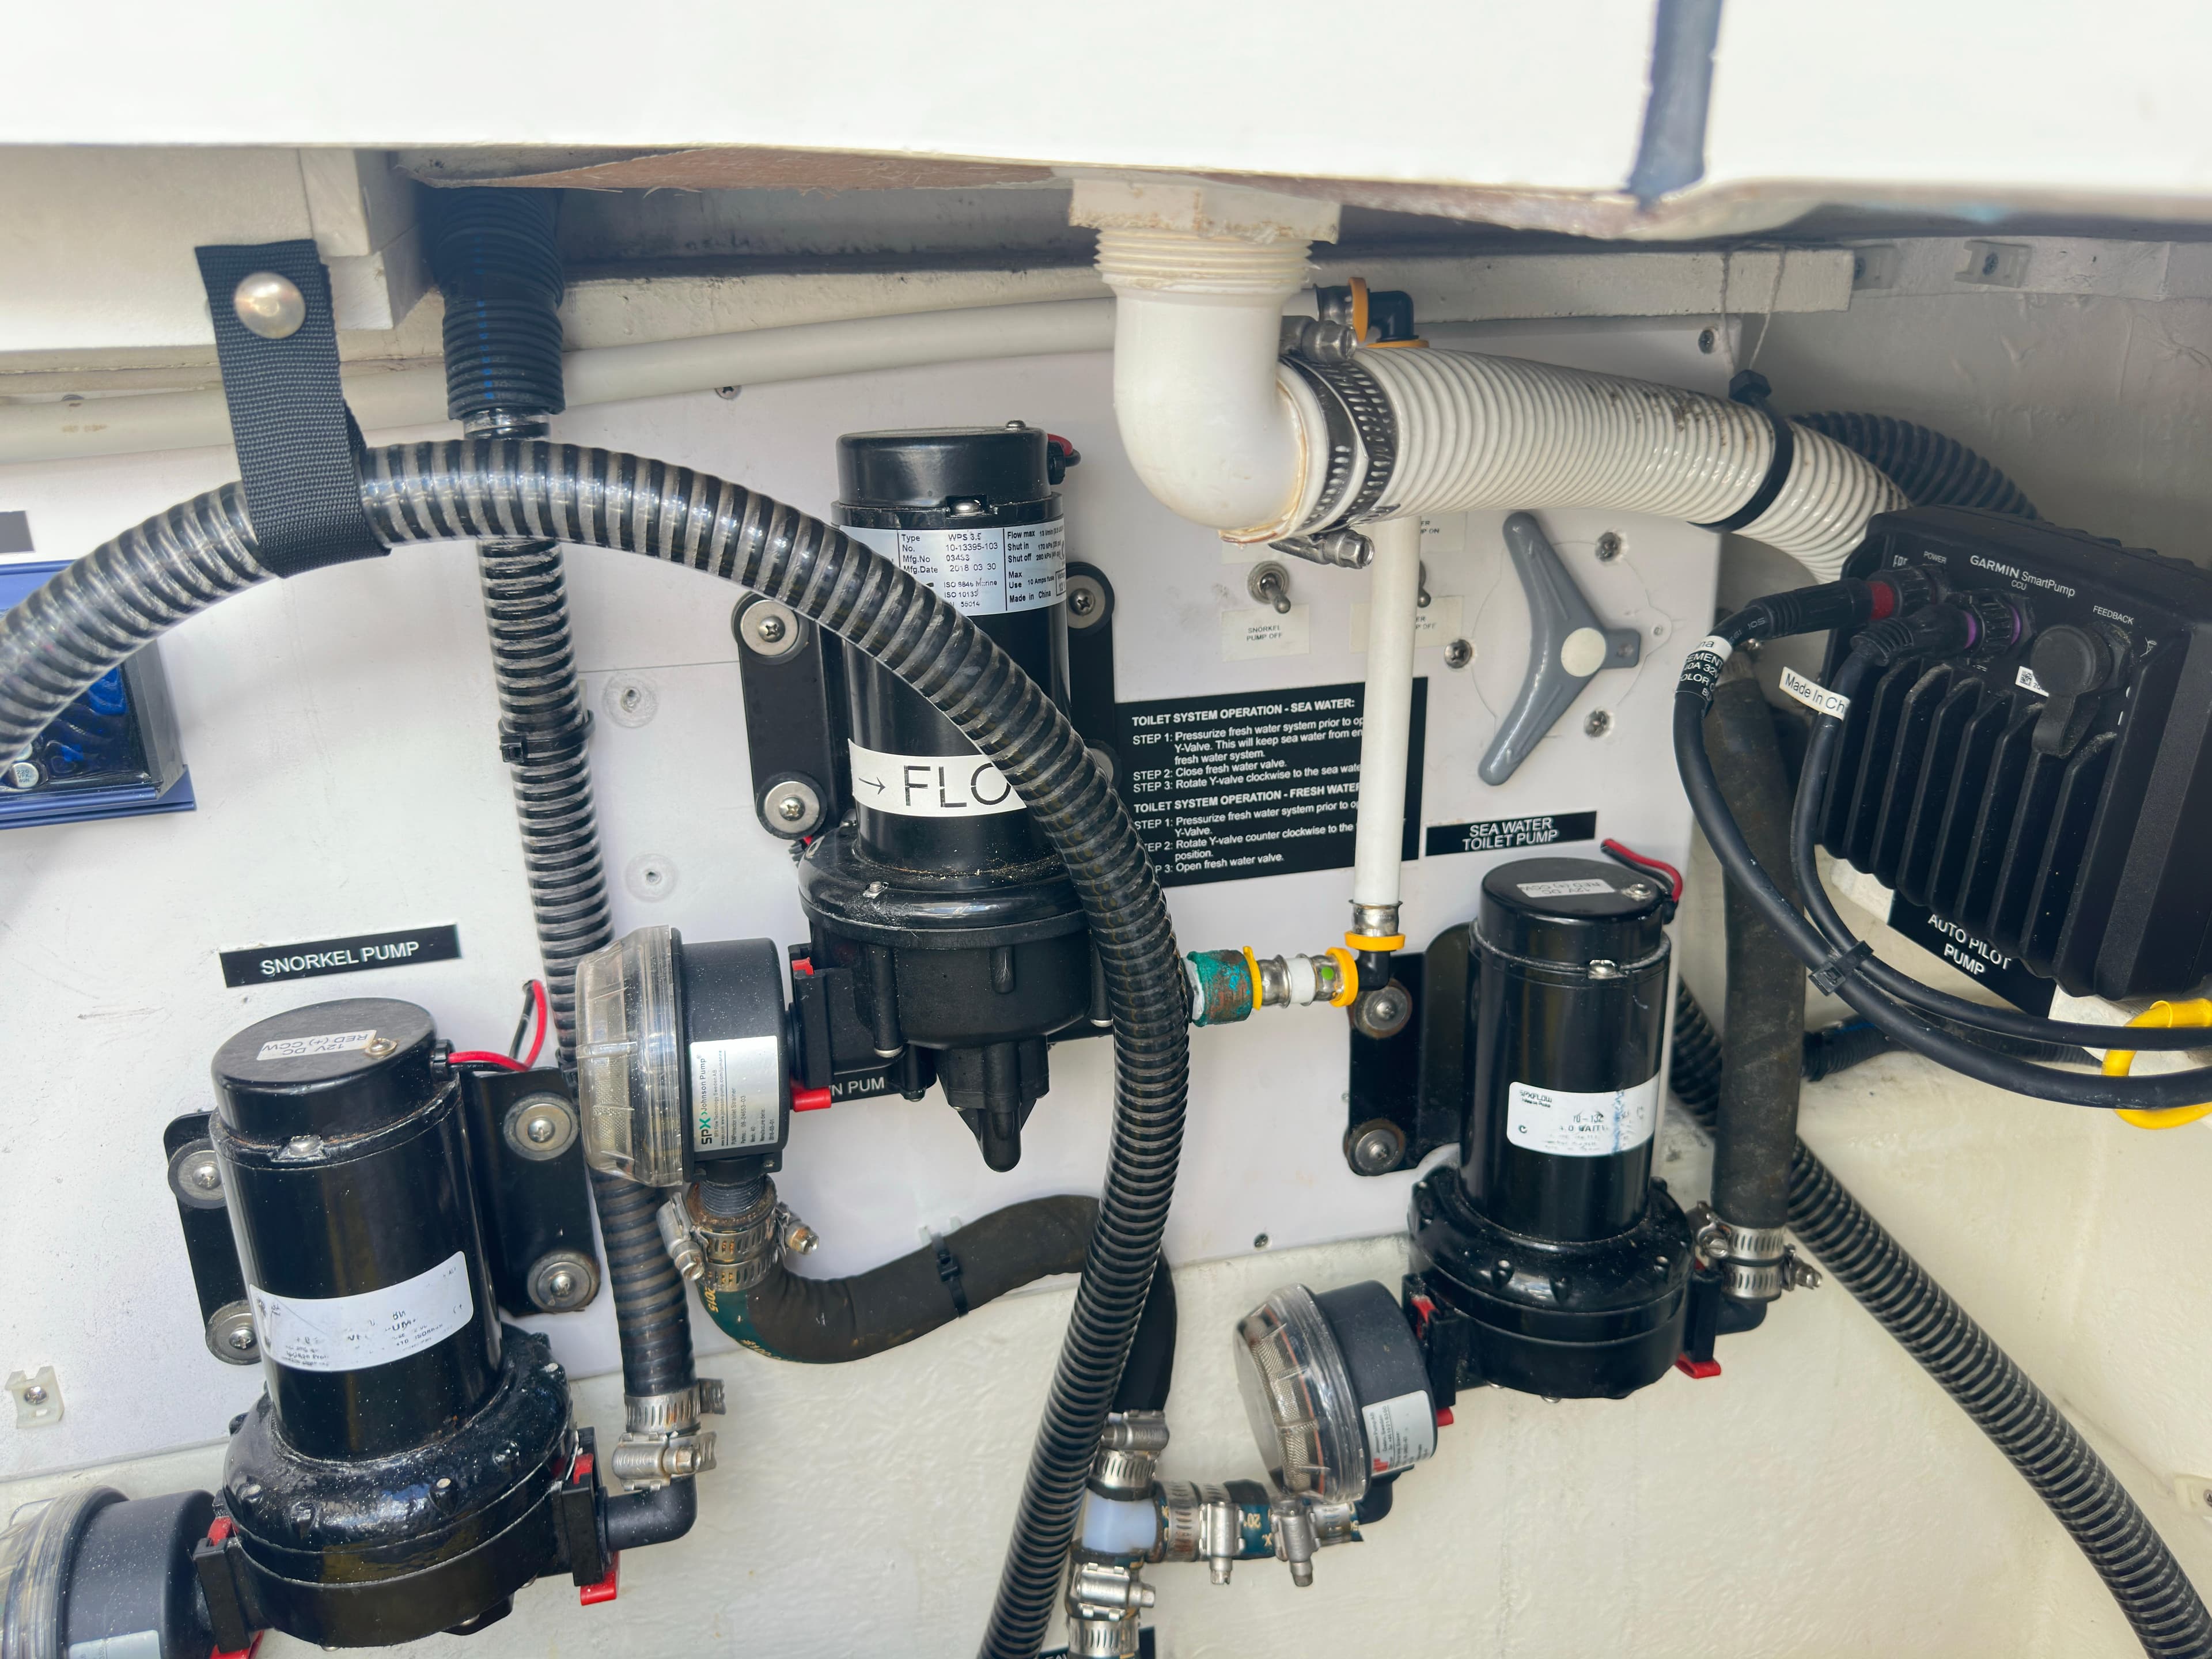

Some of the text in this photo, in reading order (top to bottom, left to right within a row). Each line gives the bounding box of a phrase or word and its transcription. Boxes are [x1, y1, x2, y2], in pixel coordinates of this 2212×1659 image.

[902, 534, 920, 542] Type
[1007, 531, 1022, 539] Flow
[946, 542, 998, 551] 10-13395-103
[1008, 543, 1022, 551] Shut
[903, 556, 930, 564] Mfg.No
[1008, 555, 1022, 563] Shut
[1923, 551, 1946, 564] POWER
[904, 566, 938, 574] Mfg.Date
[1009, 571, 1022, 579] Max
[1969, 555, 2075, 598] GARMIN SmartPump
[1035, 577, 1047, 585] Amps
[2011, 579, 2027, 590] CCU
[1009, 594, 1026, 603] Made
[1038, 590, 1051, 599] China
[2093, 605, 2134, 624] FEEDBACK
[1785, 673, 1845, 713] Made In Ch
[1132, 714, 1171, 726] TOILET
[1173, 710, 1218, 723] SYSTEM
[1219, 704, 1282, 719] OPERATION
[1290, 702, 1312, 713] SEA
[1314, 698, 1355, 710] WATER:
[1132, 733, 1161, 745] STEP
[1164, 733, 1173, 742] 1:
[1175, 729, 1226, 741] Pressurize
[1229, 725, 1252, 736] fresh
[1255, 724, 1281, 734] water
[1283, 721, 1316, 733] system
[1319, 718, 1340, 730] prior
[1342, 717, 1351, 726] to
[1175, 742, 1213, 753] Y-Valve.
[1215, 740, 1236, 749] This
[1238, 737, 1253, 748] will
[1256, 736, 1279, 746] keep
[1281, 735, 1298, 744] sea
[1300, 732, 1326, 742] water
[1328, 729, 1349, 739] from
[1175, 749, 1266, 765] fresh water system.
[1133, 759, 1287, 781] STEP 2: Close fresh water valve.
[903, 762, 1012, 808] FLO
[1133, 782, 1161, 793] STEP
[1164, 781, 1173, 790] 3:
[1176, 779, 1207, 789] Rotate
[1209, 775, 1244, 785] Y-valve
[1246, 770, 1291, 782] clockwise
[1293, 769, 1302, 777] to
[1304, 767, 1319, 777] the
[1321, 766, 1338, 775] sea
[1134, 801, 1172, 813] TOILET
[1175, 796, 1218, 809] SYSTEM
[1220, 790, 1281, 805] OPERATION
[1290, 786, 1324, 798] FRESH
[1134, 819, 1161, 830] STEP
[1165, 818, 1173, 827] 1:
[1176, 813, 1225, 825] Pressurize
[1228, 810, 1251, 820] fresh
[1253, 808, 1279, 818] water
[1282, 805, 1314, 817] system
[1316, 802, 1337, 813] prior
[1164, 841, 1173, 850] 2:
[1176, 839, 1207, 849] Rotate
[1209, 835, 1243, 846] Y-valve
[1245, 831, 1279, 842] counter
[1282, 826, 1325, 838] clockwise
[1328, 825, 1337, 833] to
[1339, 823, 1354, 832] the
[1175, 827, 1213, 837] Y-Valve.
[1469, 817, 1552, 838] SEA WATER
[1463, 830, 1559, 851] TOILET PUMP
[1164, 865, 1173, 873] 3:
[1176, 862, 1202, 873] Open
[1204, 859, 1228, 869] fresh
[1229, 856, 1255, 866] water
[1257, 853, 1284, 863] valve.
[1175, 850, 1214, 862] position.
[1927, 914, 2012, 970] AUTO PILOT
[260, 941, 419, 975] SNORKEL PUMP
[1944, 943, 1985, 975] PUMP
[262, 1041, 303, 1051] CCW
[334, 1034, 368, 1043] RED
[283, 1043, 344, 1055] 12V DC
[848, 1077, 885, 1094] PUM
[699, 1117, 713, 1145] SPX
